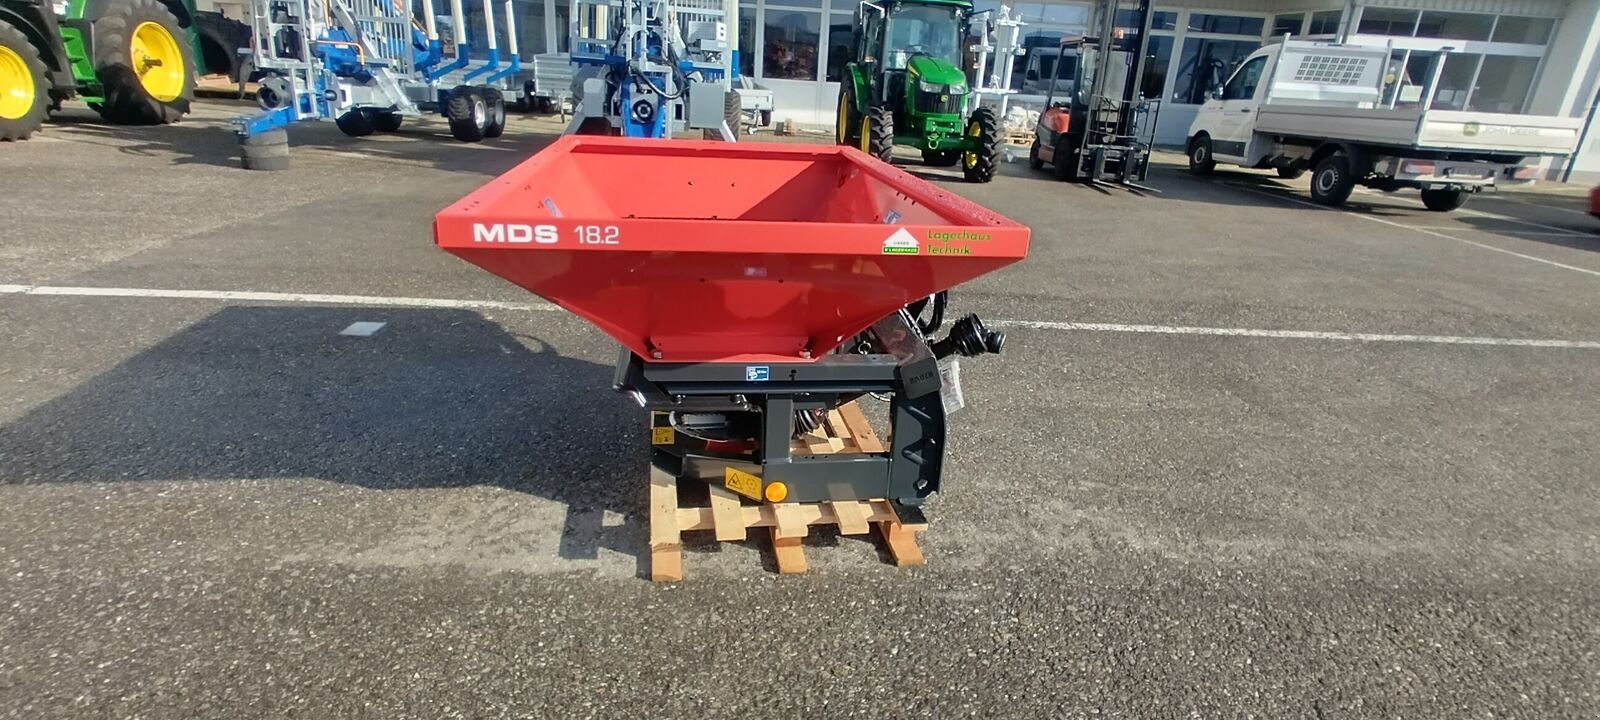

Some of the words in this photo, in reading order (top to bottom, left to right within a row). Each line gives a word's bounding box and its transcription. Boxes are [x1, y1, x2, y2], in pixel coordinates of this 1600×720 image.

[472, 223, 559, 244] MDS
[574, 225, 620, 245] 18.2
[928, 229, 991, 242] Lagerhaus
[928, 244, 970, 254] Technik
